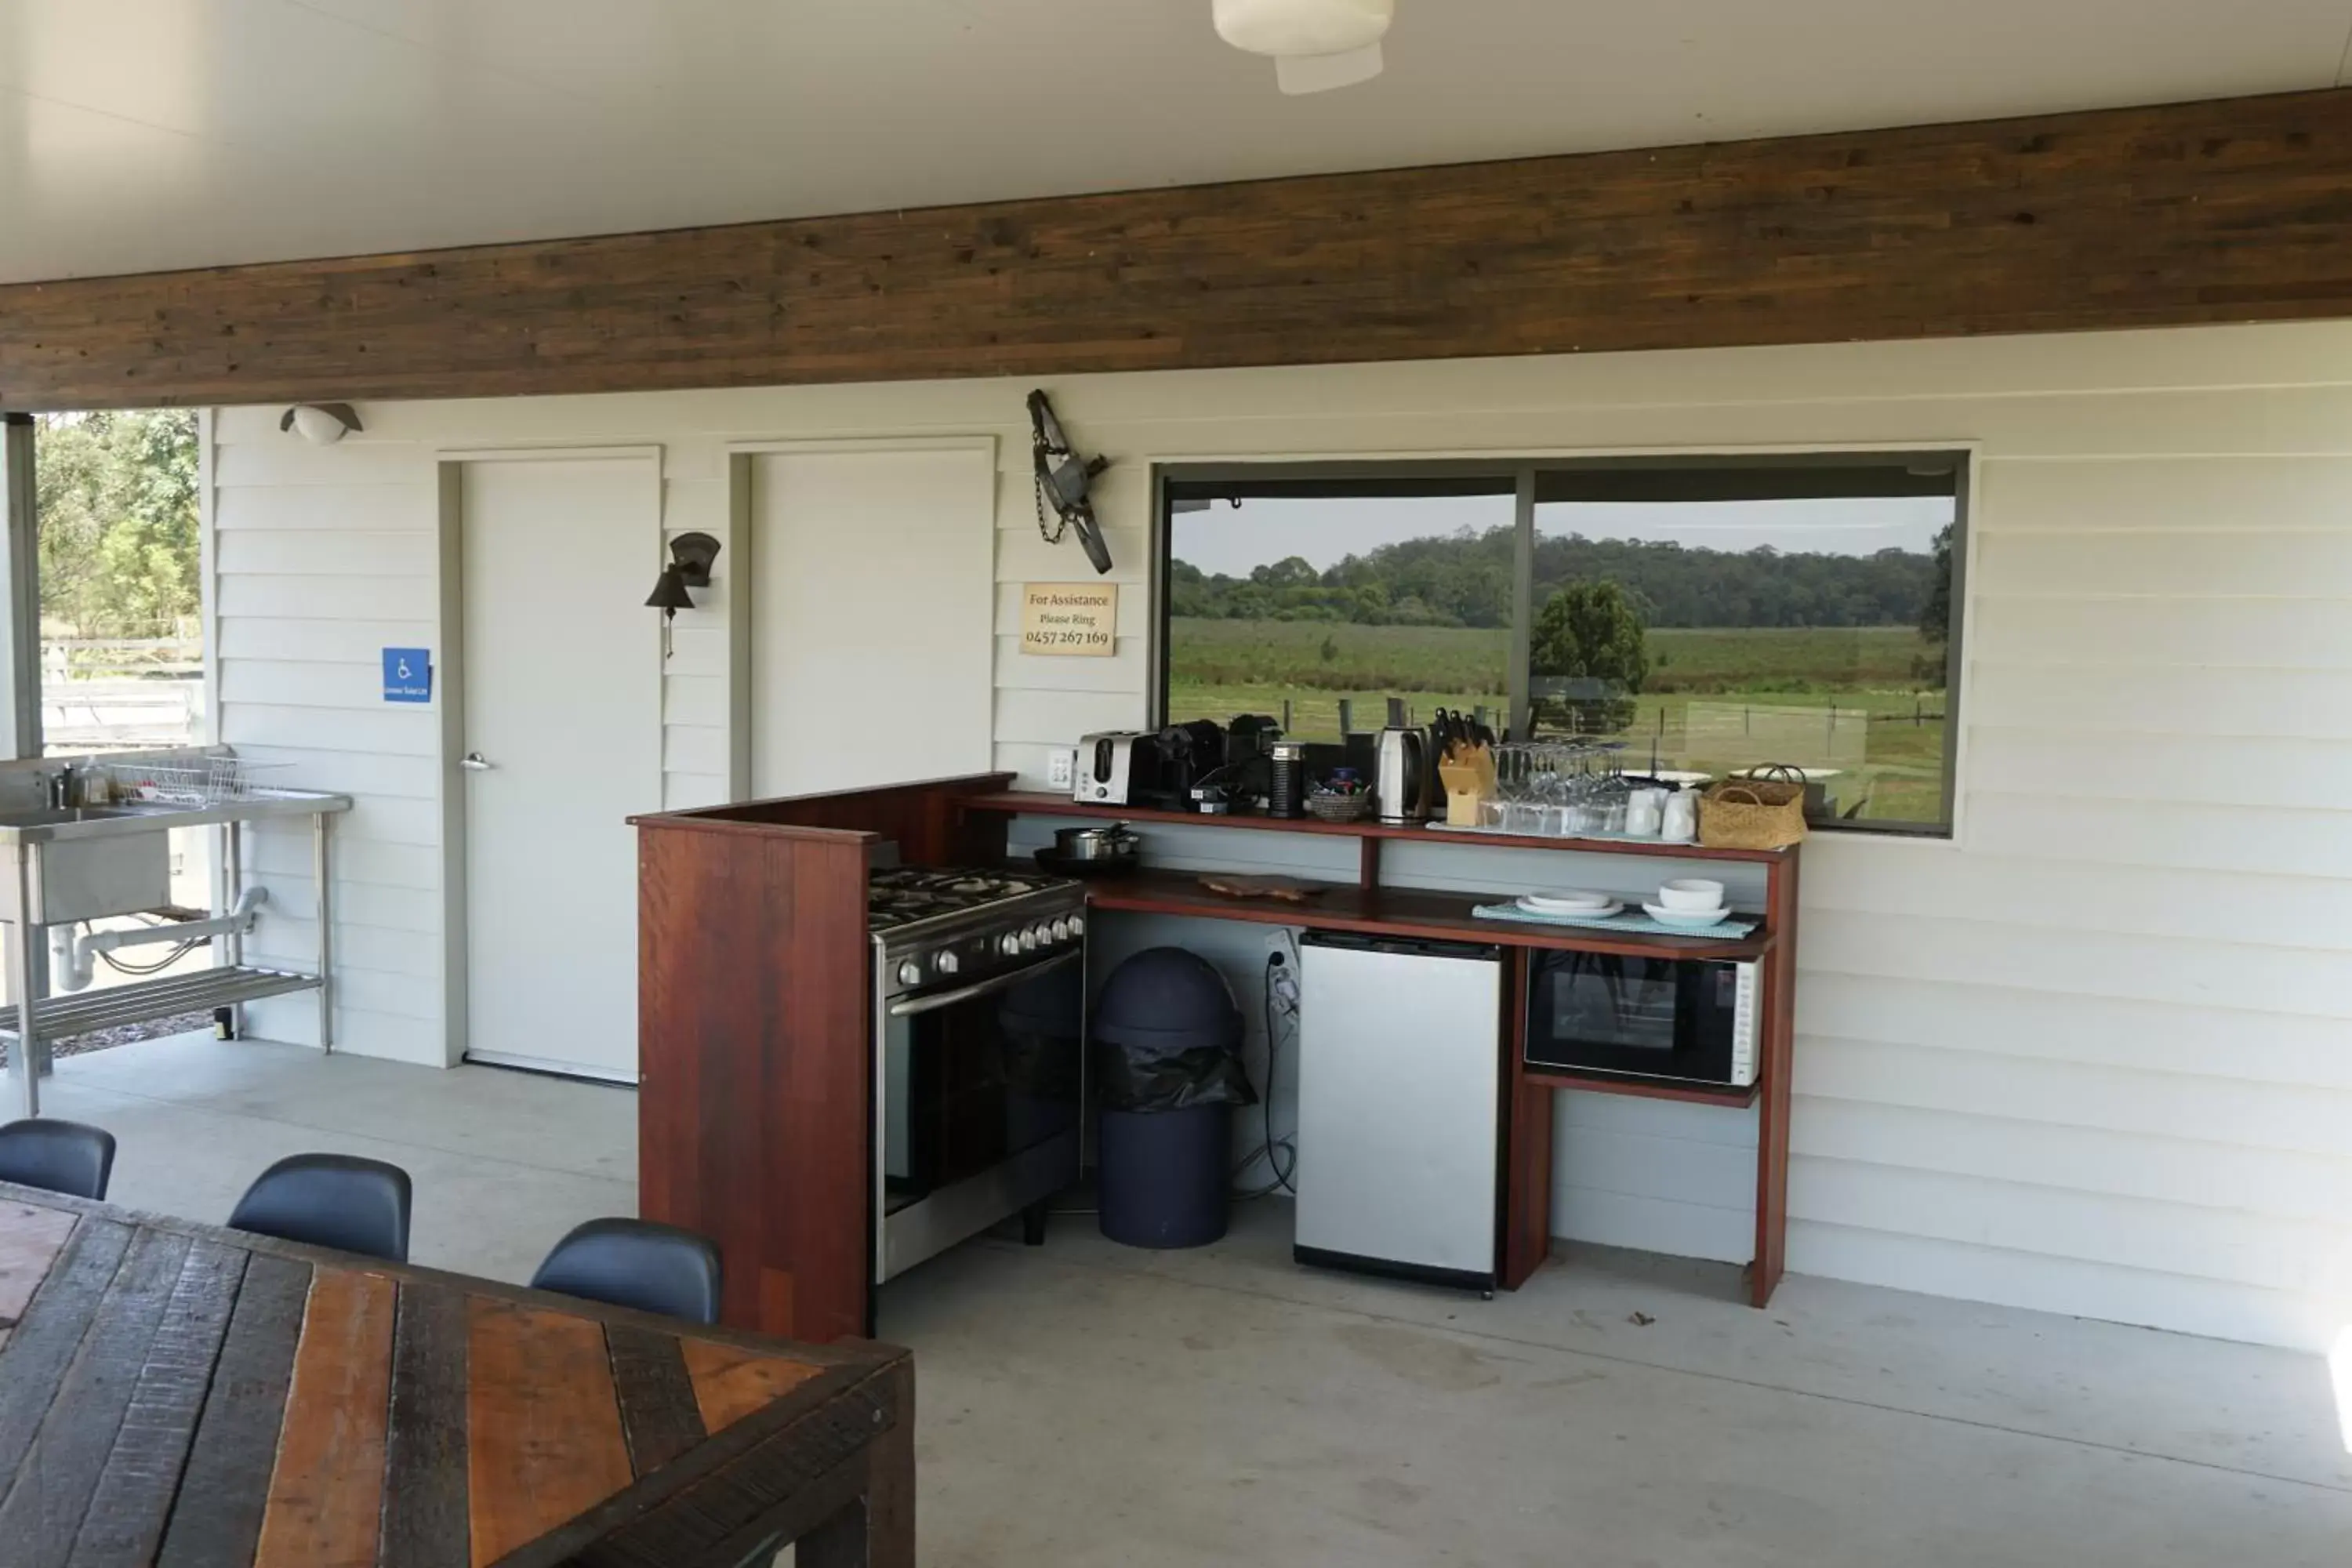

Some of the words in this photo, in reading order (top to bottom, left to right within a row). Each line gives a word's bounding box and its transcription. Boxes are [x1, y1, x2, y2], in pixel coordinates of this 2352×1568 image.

[1029, 593, 1048, 605] For
[1051, 593, 1109, 607] Assistance
[1040, 613, 1070, 624] Please
[1072, 614, 1096, 628] Ring
[1026, 631, 1058, 645] 0457
[1058, 630, 1083, 645] 267
[1087, 631, 1109, 646] 169
